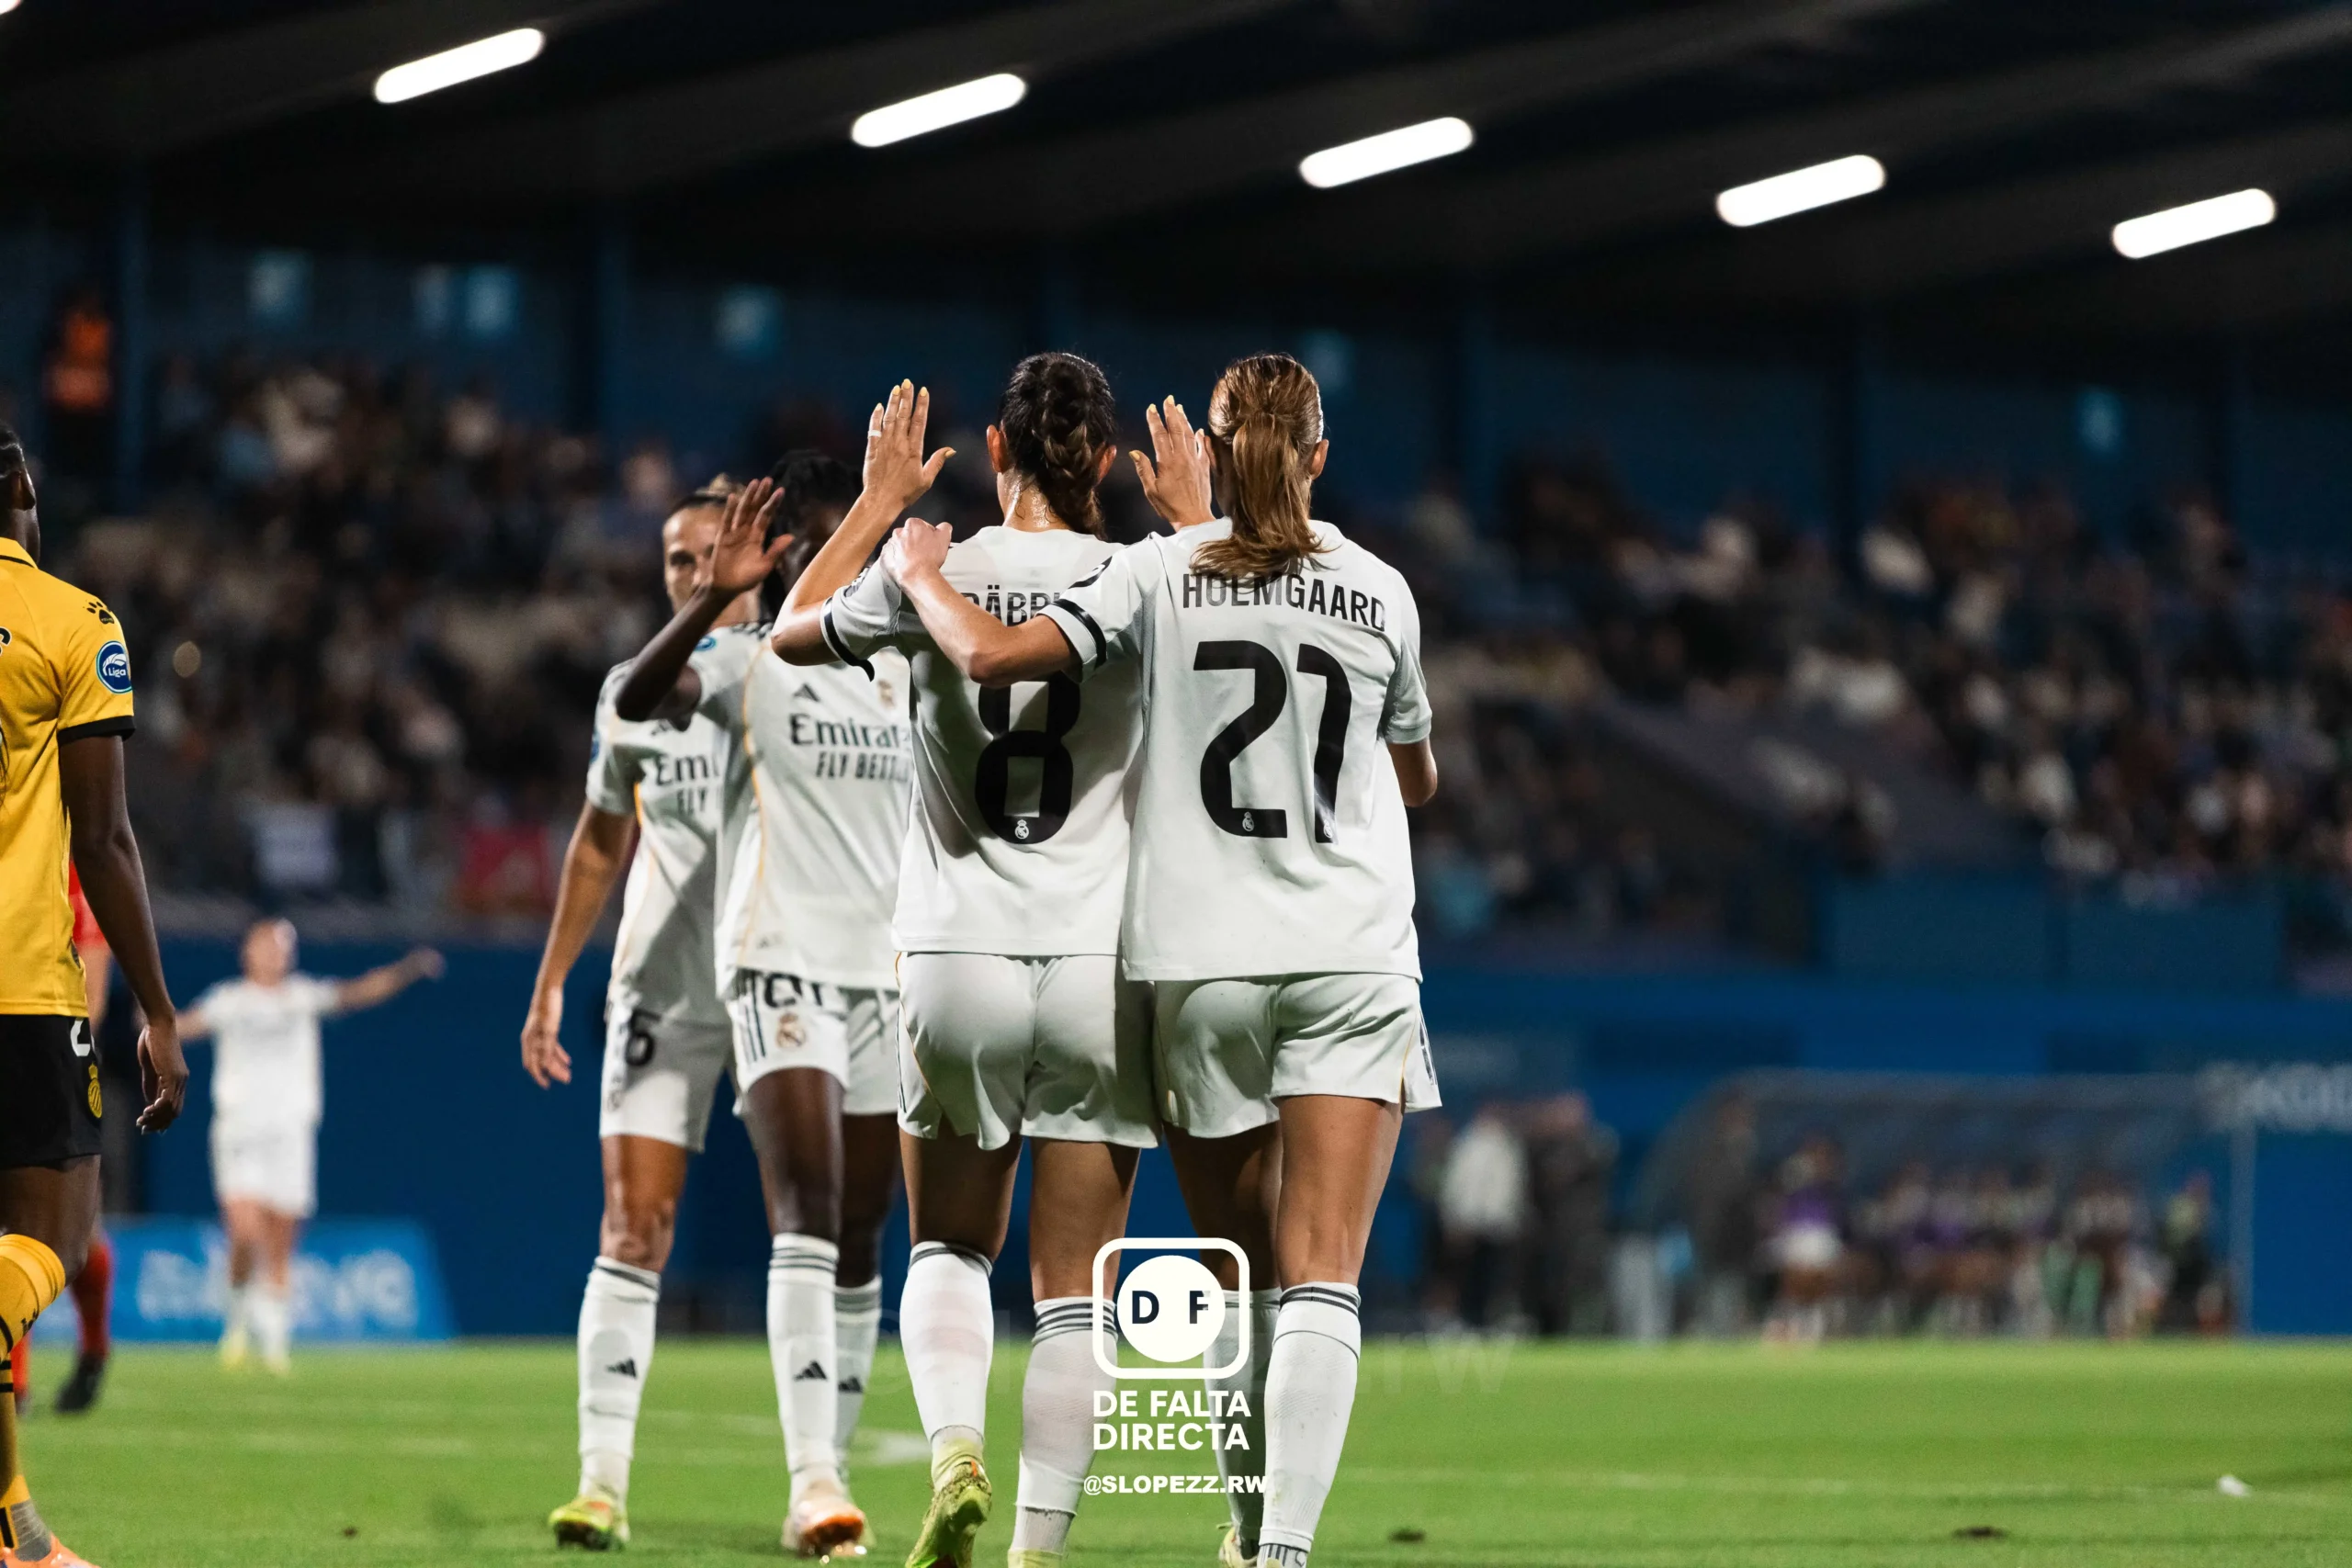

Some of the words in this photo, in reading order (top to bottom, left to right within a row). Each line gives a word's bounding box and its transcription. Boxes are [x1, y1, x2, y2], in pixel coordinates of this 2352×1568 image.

[107, 667, 127, 678] Liga
[975, 669, 1080, 845] 8
[1193, 639, 1352, 844] 21
